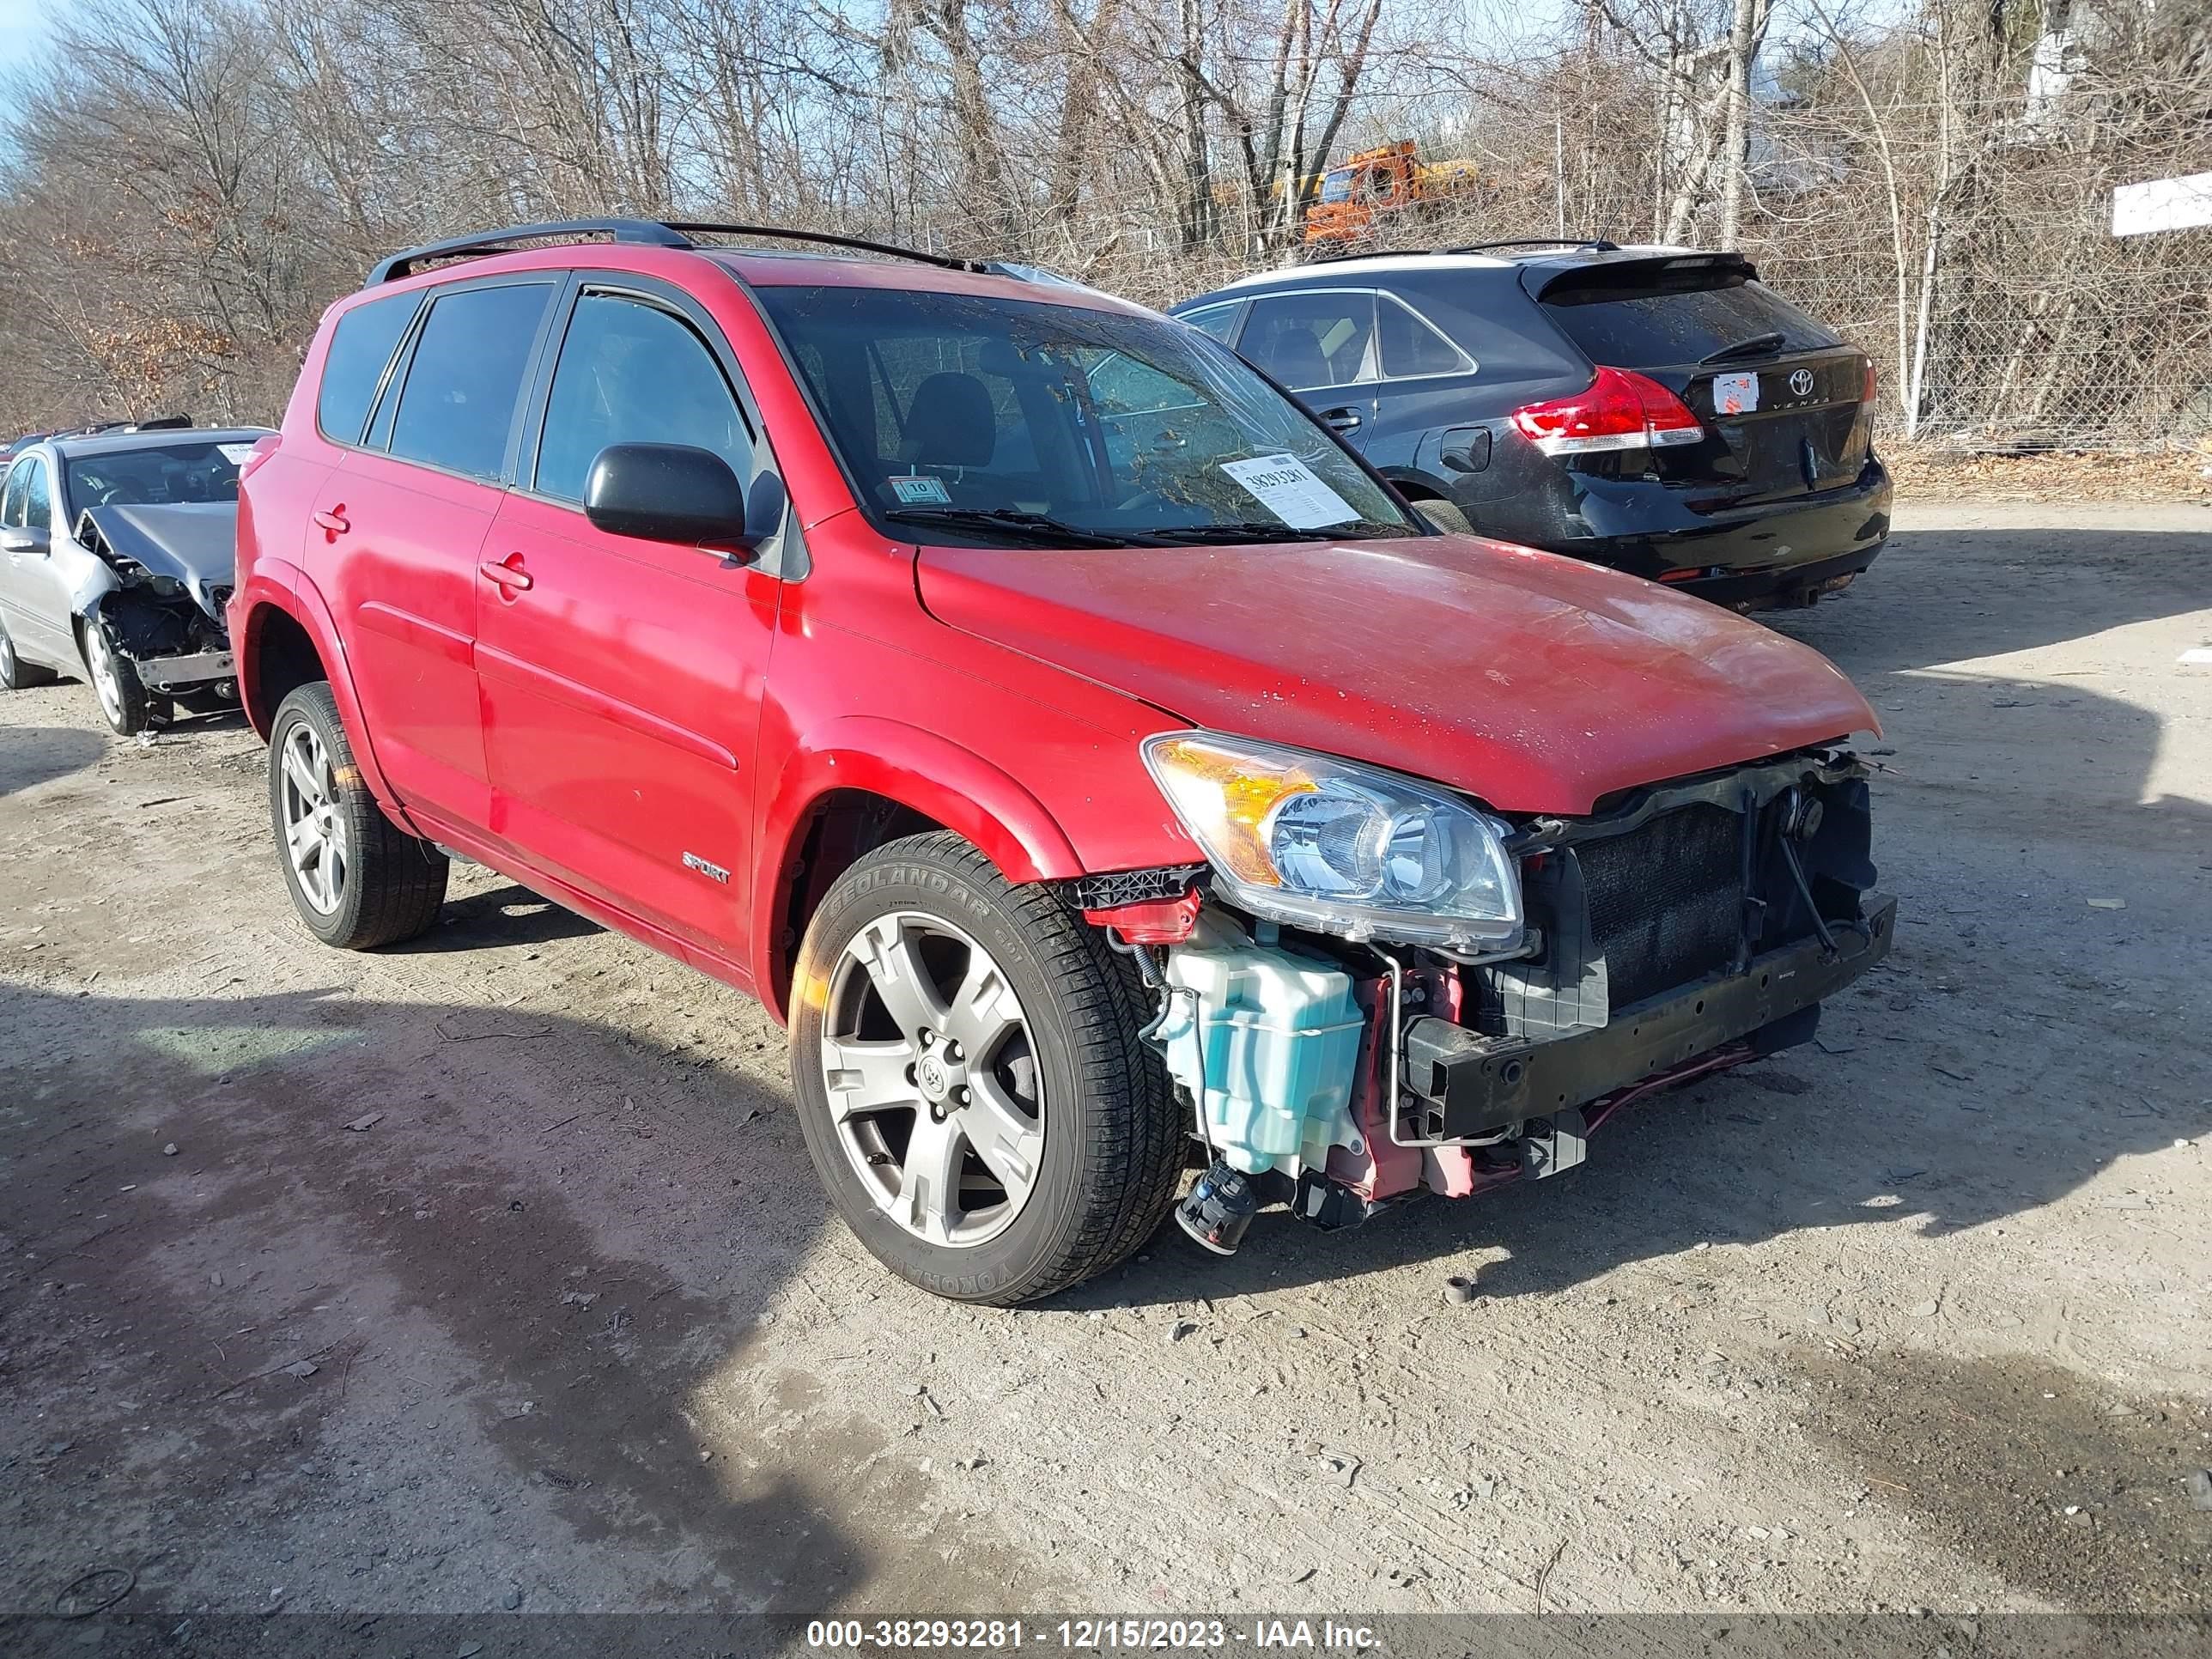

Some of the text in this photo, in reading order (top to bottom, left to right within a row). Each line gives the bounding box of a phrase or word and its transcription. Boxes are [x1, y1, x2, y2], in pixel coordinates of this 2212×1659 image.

[1772, 397, 1830, 410] VENZA
[909, 483, 927, 492] 10
[1245, 468, 1310, 490] 38293281
[683, 851, 731, 884] SPORT
[829, 868, 990, 923] GEOLANDAR
